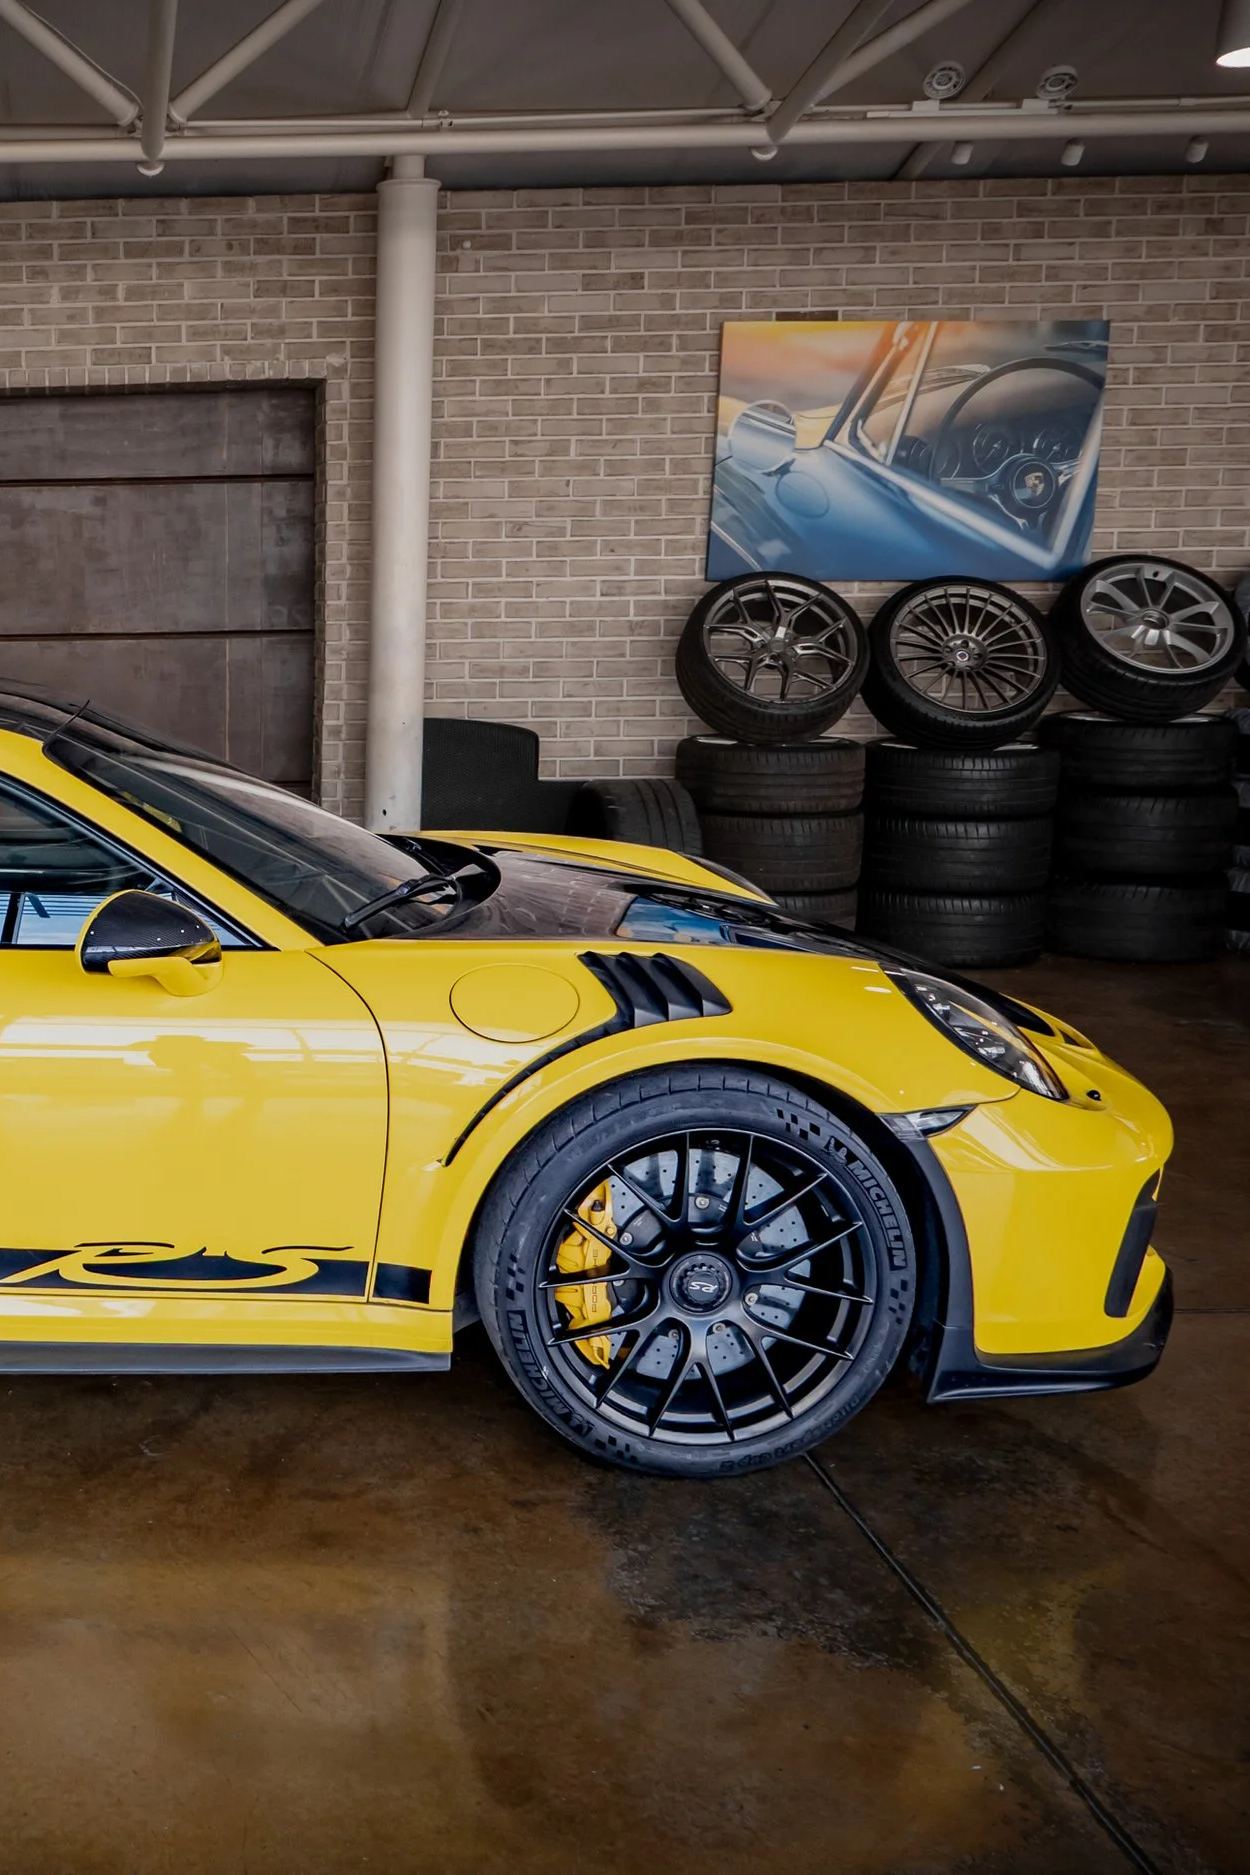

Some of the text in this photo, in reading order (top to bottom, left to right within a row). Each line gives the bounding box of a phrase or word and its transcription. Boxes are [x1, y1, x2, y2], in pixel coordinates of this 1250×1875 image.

[848, 1160, 907, 1267] MICHELIN
[0, 1242, 354, 1290] RS
[508, 1311, 570, 1415] MICHELIN
